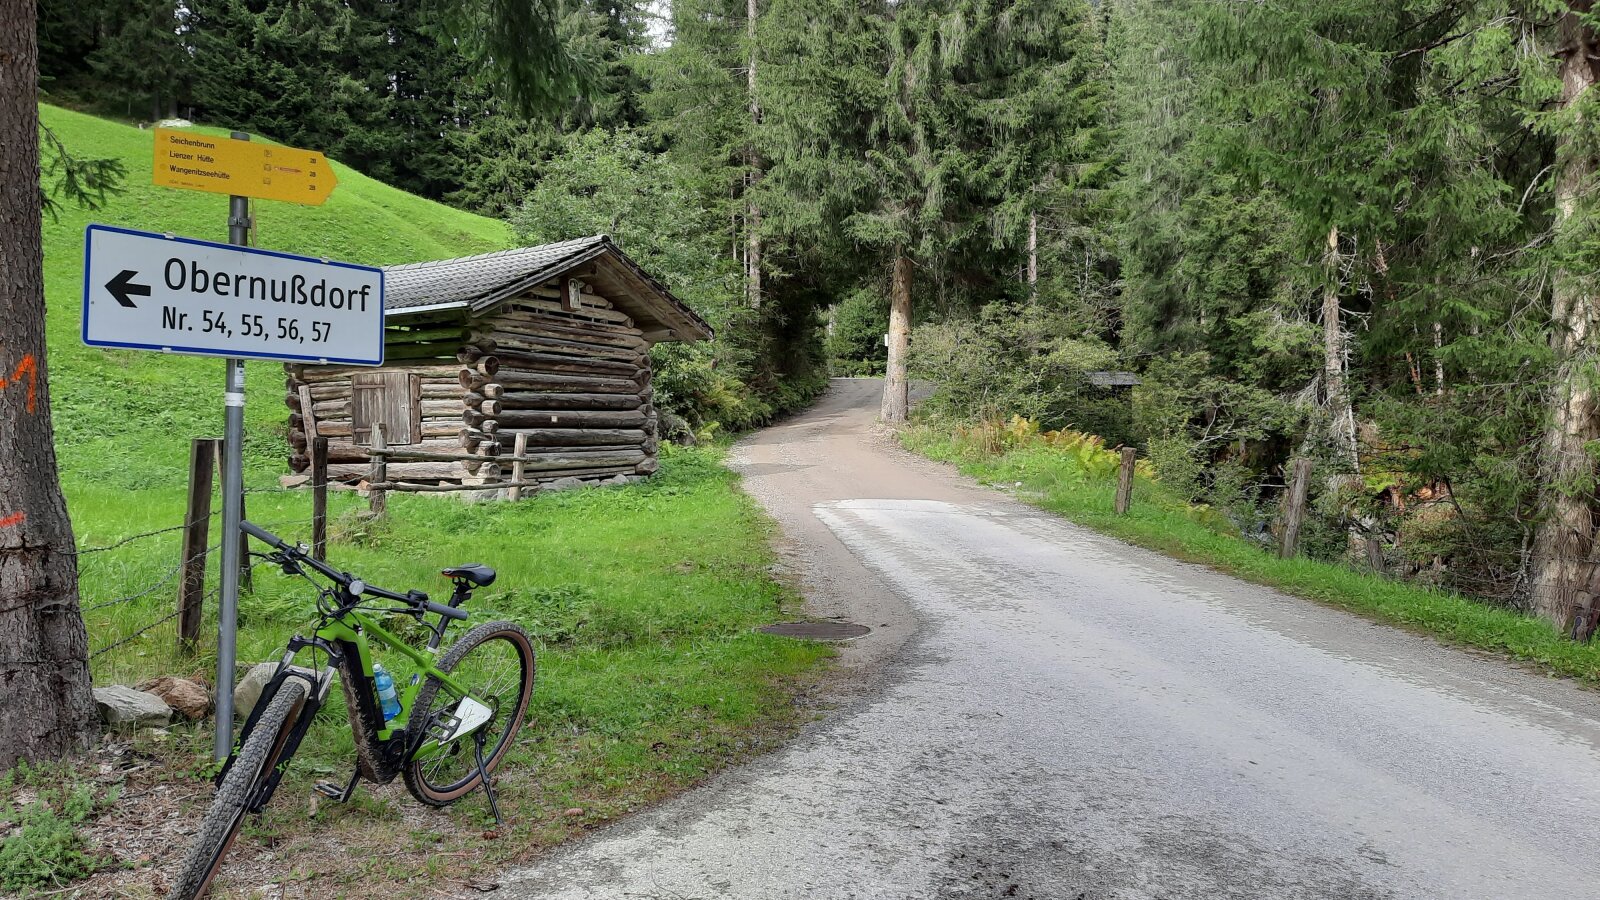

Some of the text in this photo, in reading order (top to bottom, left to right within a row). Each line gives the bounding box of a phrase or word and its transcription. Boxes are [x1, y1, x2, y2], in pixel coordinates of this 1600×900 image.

[170, 135, 215, 149] Seichenbrunn
[169, 150, 214, 163] Lienzer Hütte
[169, 164, 230, 179] Wangenitzseehütte
[164, 257, 370, 312] Obernußdorf
[162, 305, 331, 344] Nr. 54, 55, 56, 57
